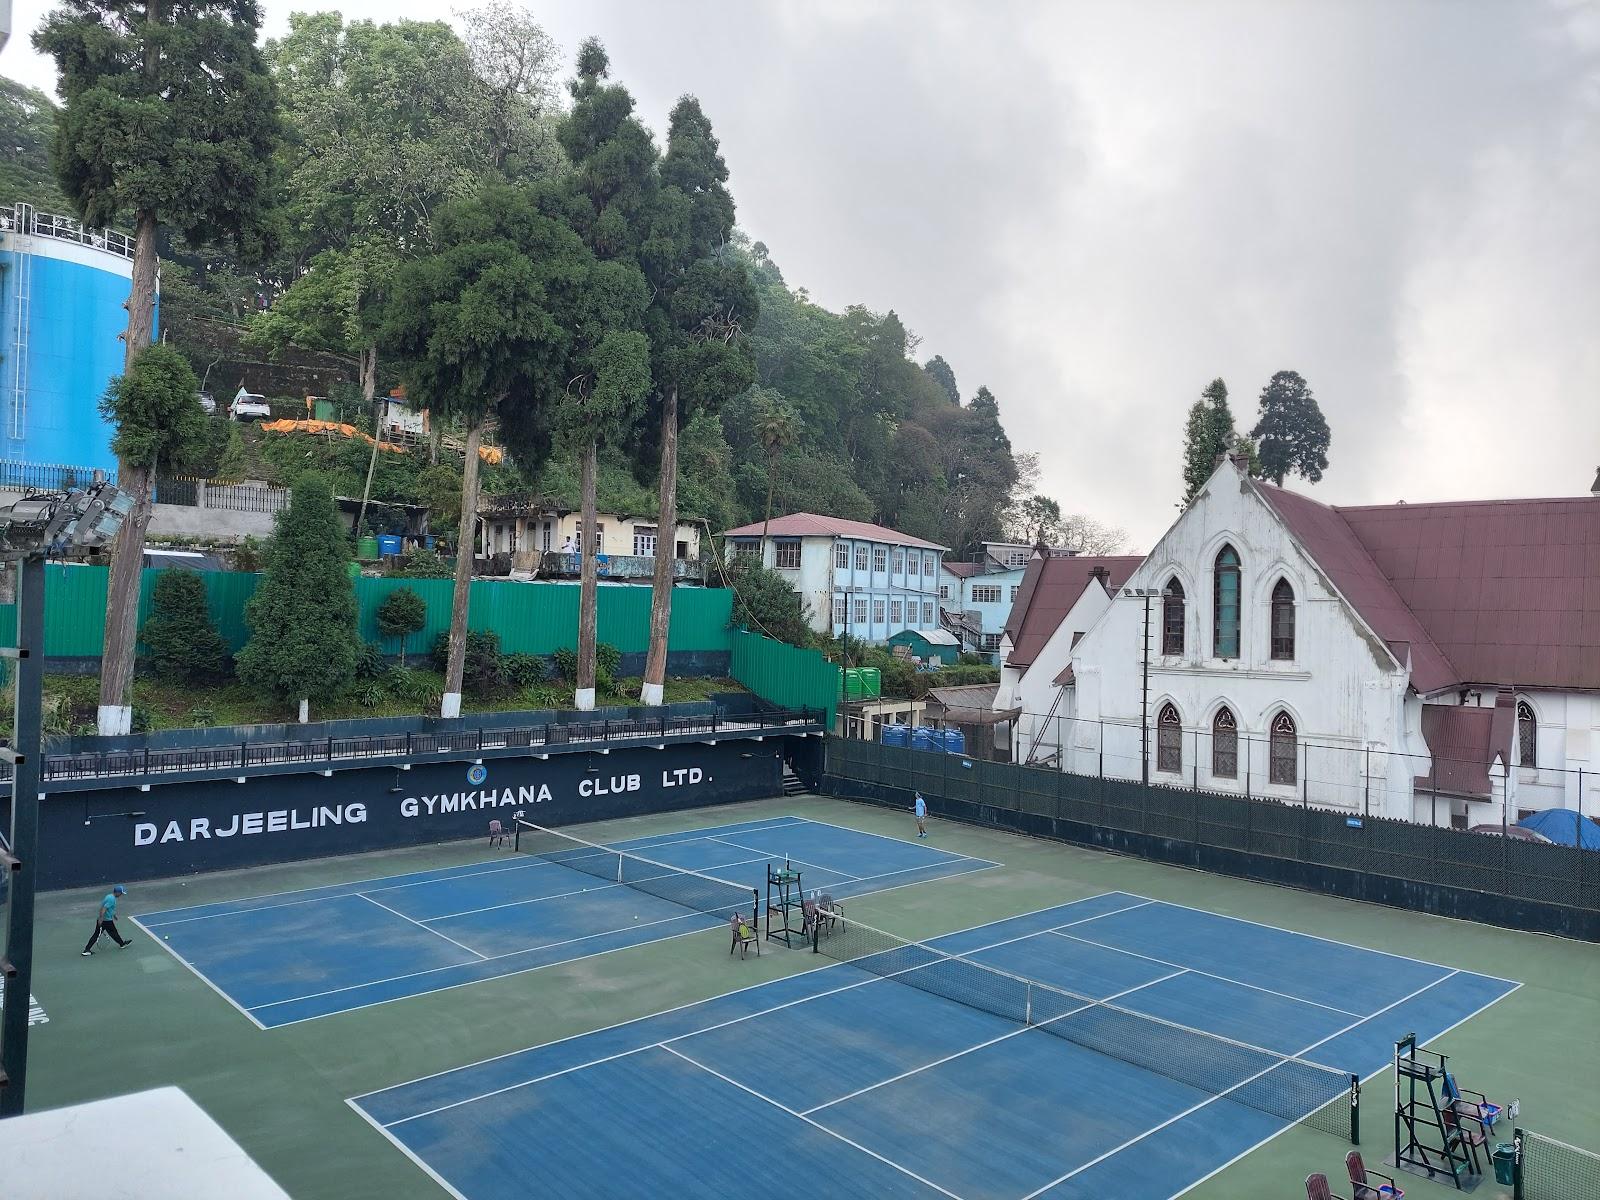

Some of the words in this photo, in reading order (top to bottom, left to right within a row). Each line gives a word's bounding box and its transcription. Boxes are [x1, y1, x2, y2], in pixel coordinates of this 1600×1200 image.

[134, 802, 367, 846] DARJEELING
[400, 784, 553, 818] GYMKHANA
[578, 774, 641, 797] CLUB
[662, 767, 713, 788] LTD.
